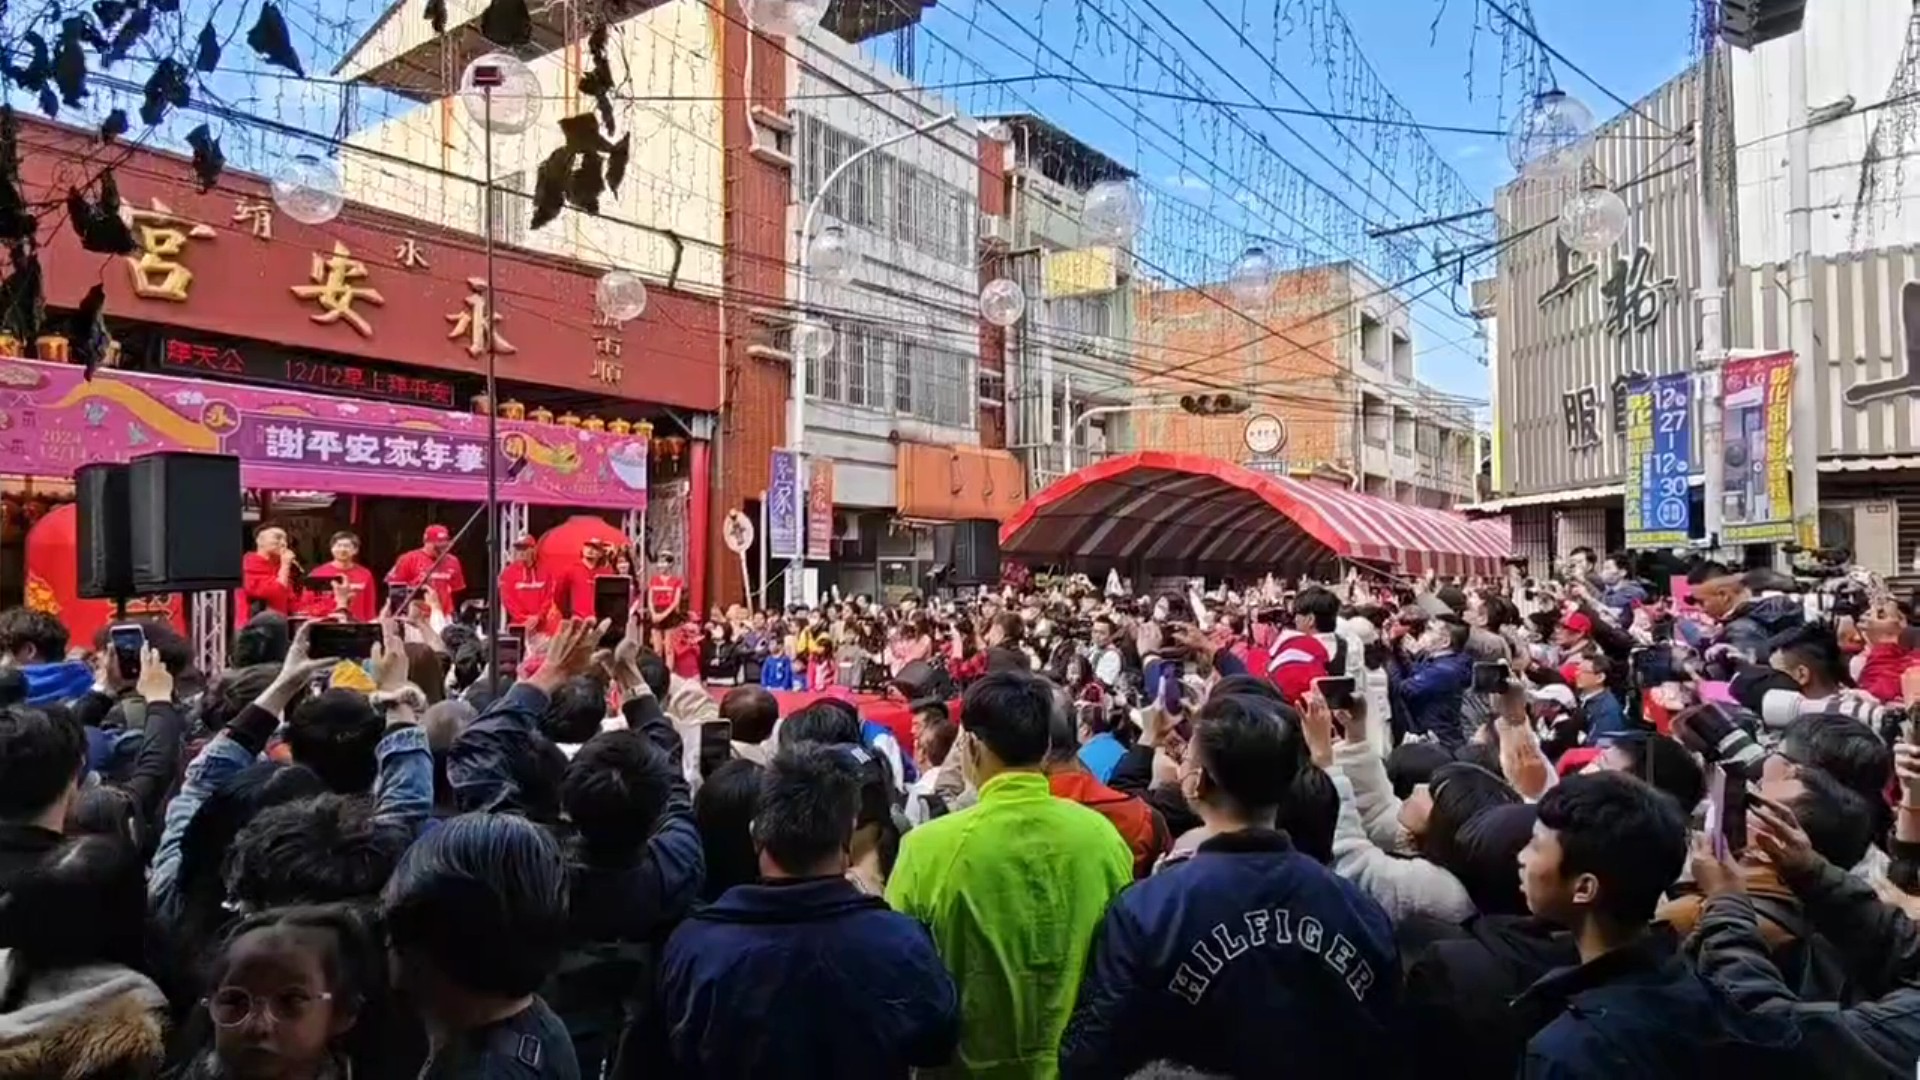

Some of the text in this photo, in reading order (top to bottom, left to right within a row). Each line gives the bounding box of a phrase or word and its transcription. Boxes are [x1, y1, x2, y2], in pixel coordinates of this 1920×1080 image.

[1745, 373, 1766, 389] LG
[1653, 388, 1675, 410] 12
[1660, 411, 1686, 433] 27
[41, 429, 82, 446] 2024
[265, 425, 487, 473] 謝平安家年華
[1653, 453, 1675, 473] 12
[1660, 477, 1687, 497] 30
[1168, 908, 1375, 1005] HILFIGER
